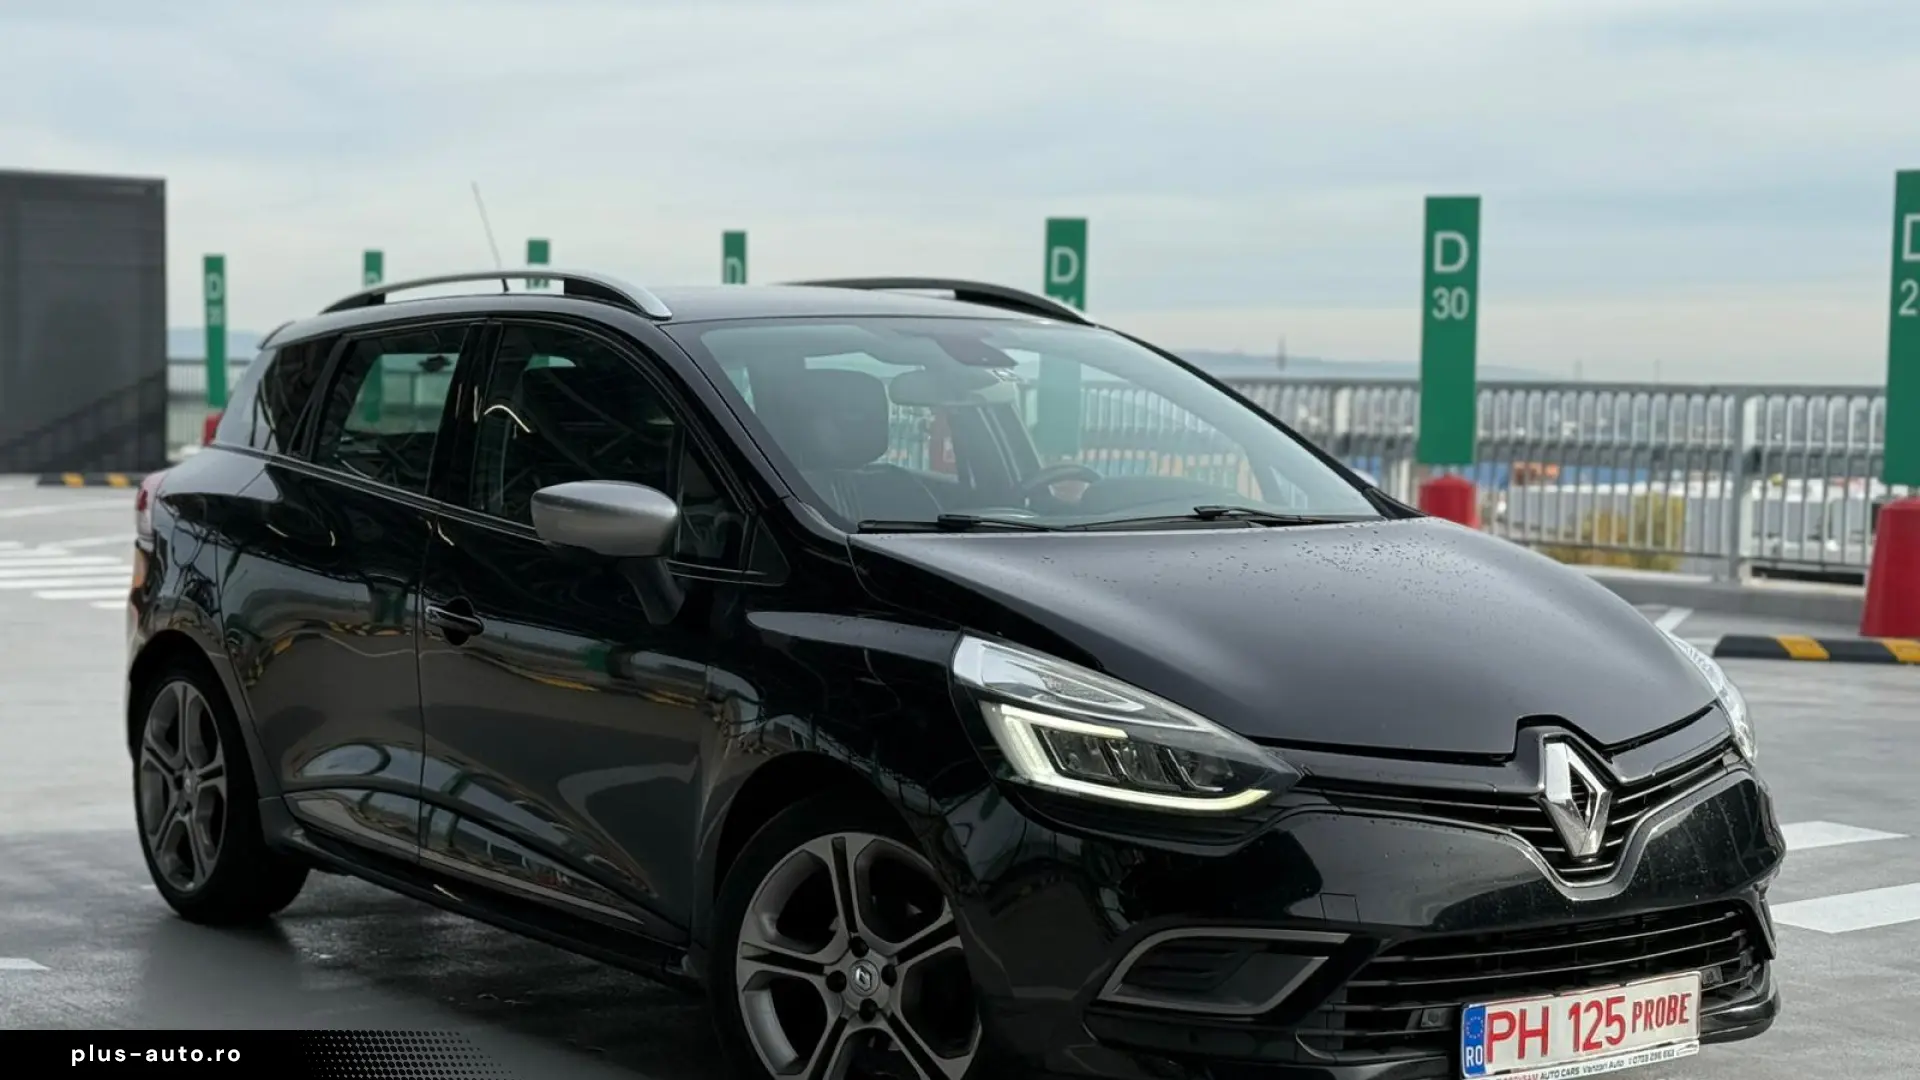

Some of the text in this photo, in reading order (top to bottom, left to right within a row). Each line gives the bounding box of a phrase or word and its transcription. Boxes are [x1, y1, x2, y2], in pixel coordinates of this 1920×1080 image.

[1051, 245, 1079, 284] D
[1433, 230, 1469, 273] D
[1432, 286, 1470, 320] 30
[1899, 278, 1920, 316] 2
[1487, 993, 1692, 1063] PH 125 PROBE
[1466, 1046, 1483, 1067] RO
[1561, 1065, 1579, 1077] CARS
